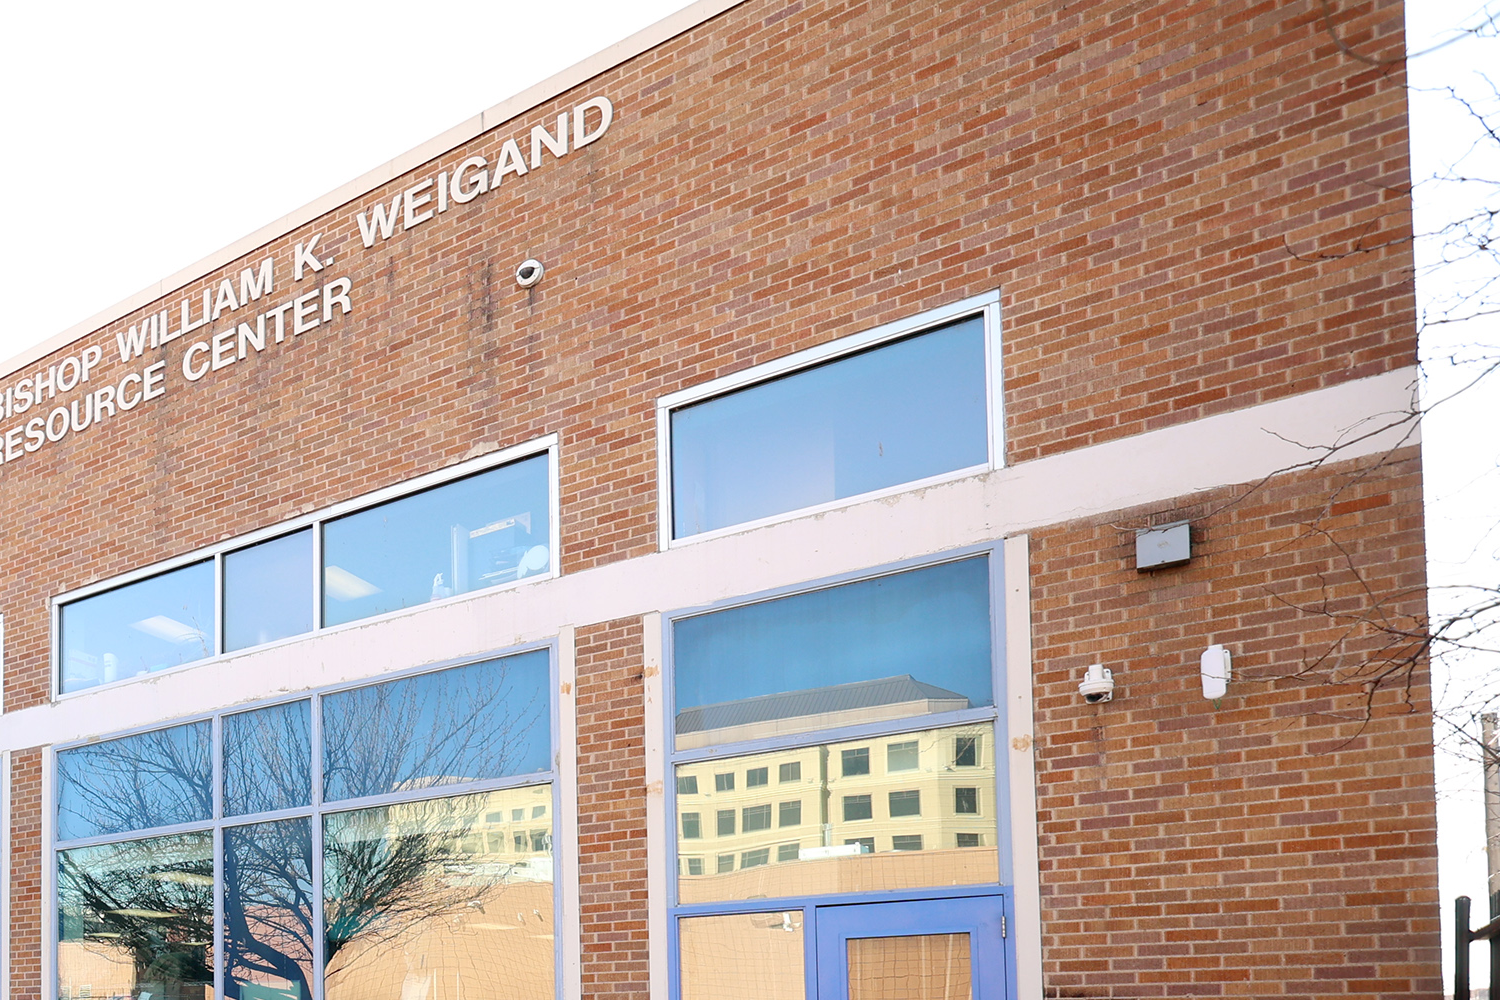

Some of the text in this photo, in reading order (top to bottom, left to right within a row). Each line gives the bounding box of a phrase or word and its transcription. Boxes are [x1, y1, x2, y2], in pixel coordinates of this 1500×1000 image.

[116, 256, 274, 363] WILLIAM
[294, 232, 335, 282] K.
[355, 95, 614, 249] WEIGAND
[182, 276, 353, 382] CENTER
